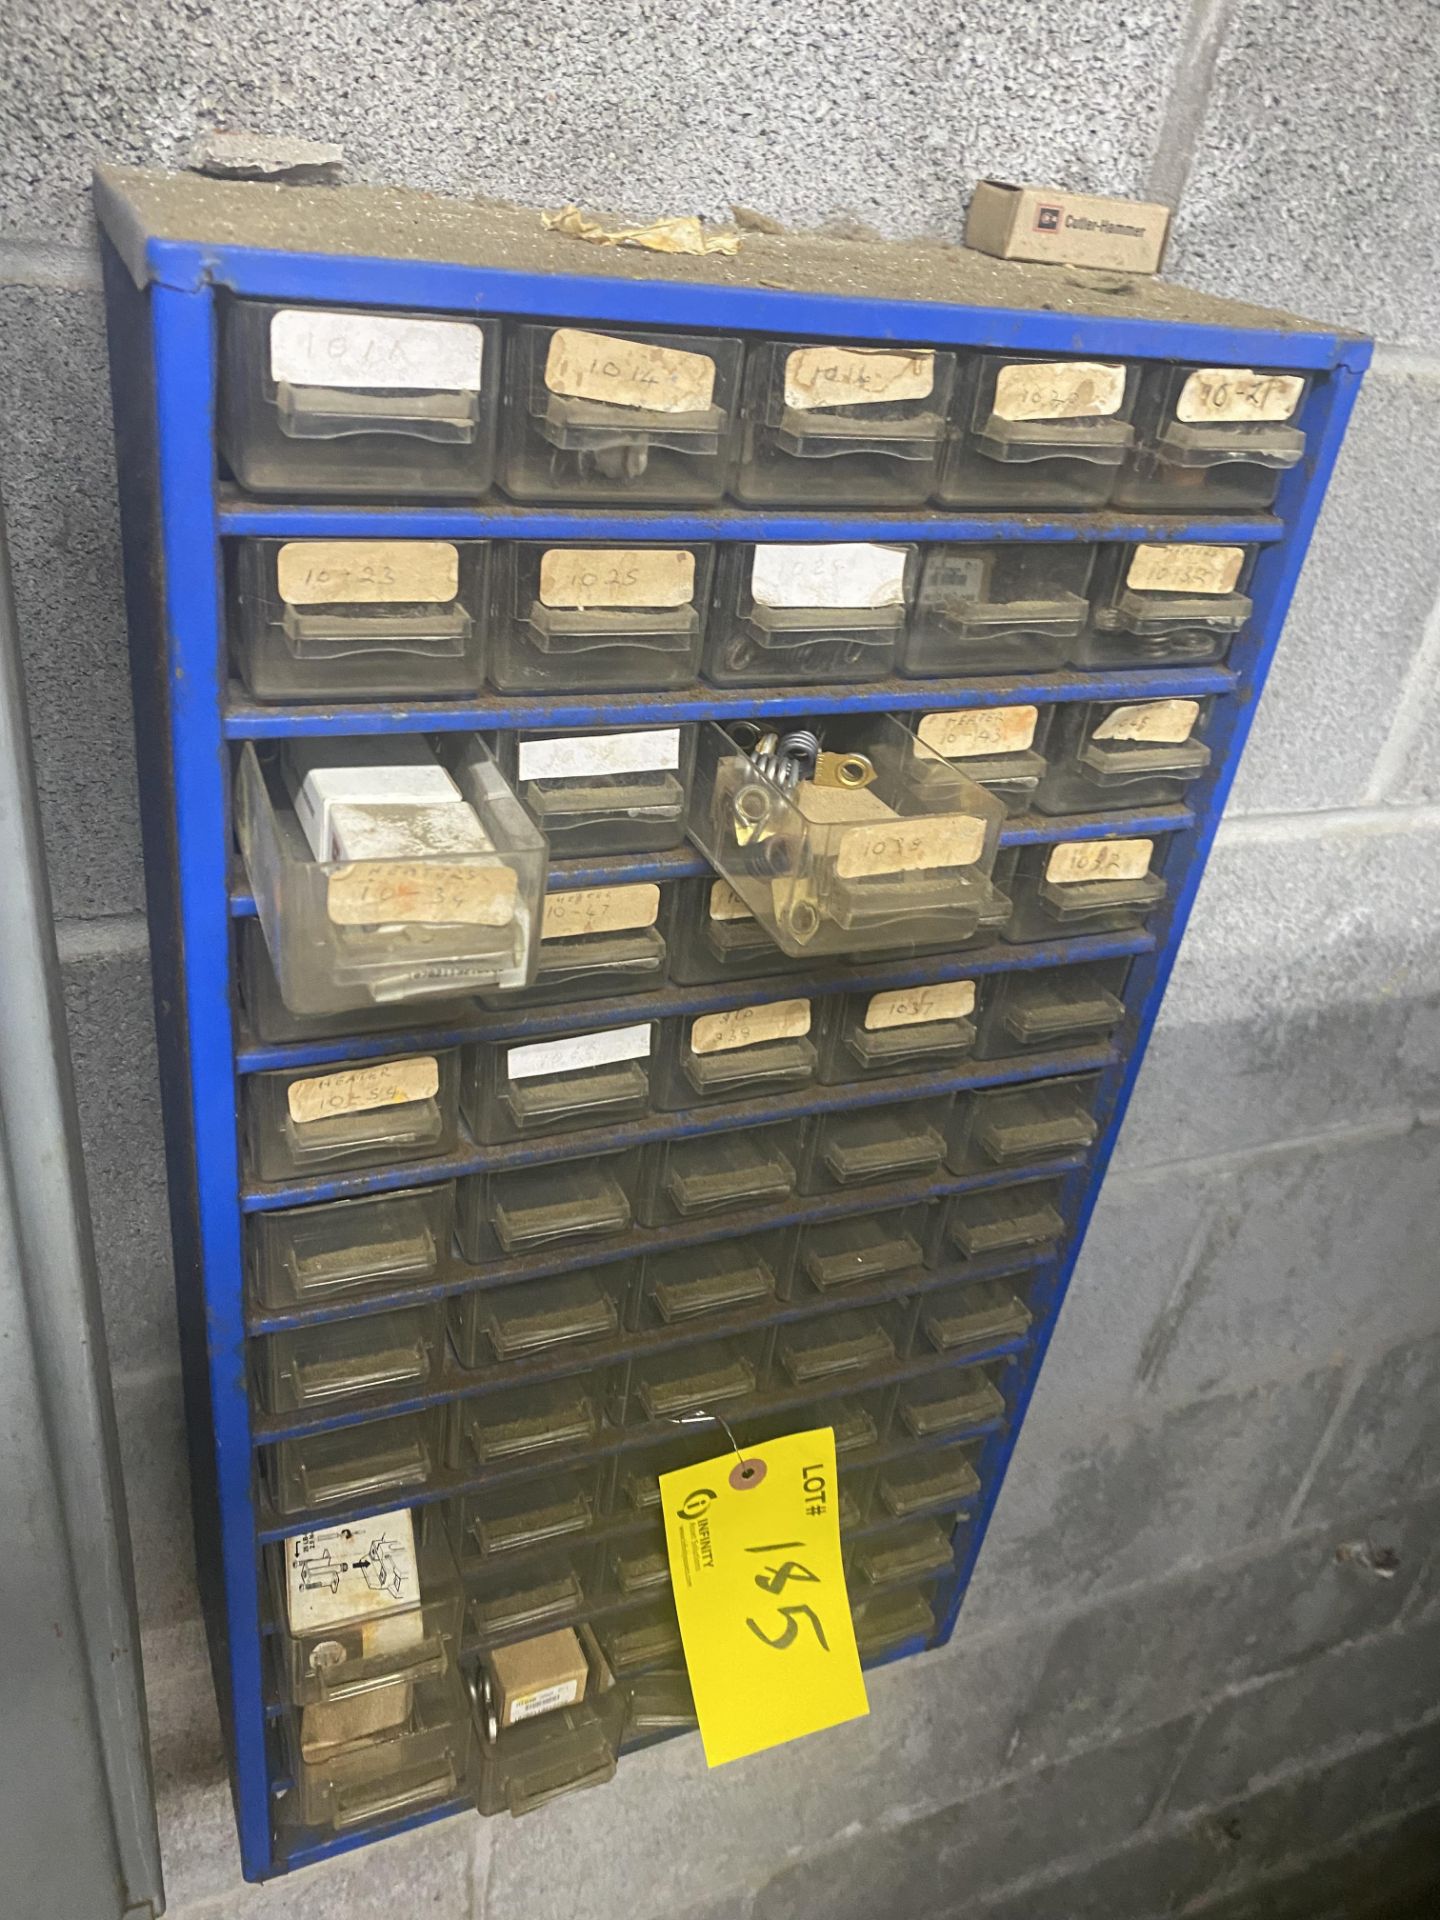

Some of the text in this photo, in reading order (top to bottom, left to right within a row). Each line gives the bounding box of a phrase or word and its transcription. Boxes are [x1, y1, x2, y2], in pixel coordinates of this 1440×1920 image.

[1065, 214, 1146, 238] Cutler-Hammer
[588, 360, 662, 385] 1014
[569, 568, 639, 587] 1025
[319, 1067, 392, 1088] HEATER
[802, 1464, 827, 1517] LOT#
[697, 1517, 715, 1568] INFINITY
[743, 1541, 831, 1653] 185
